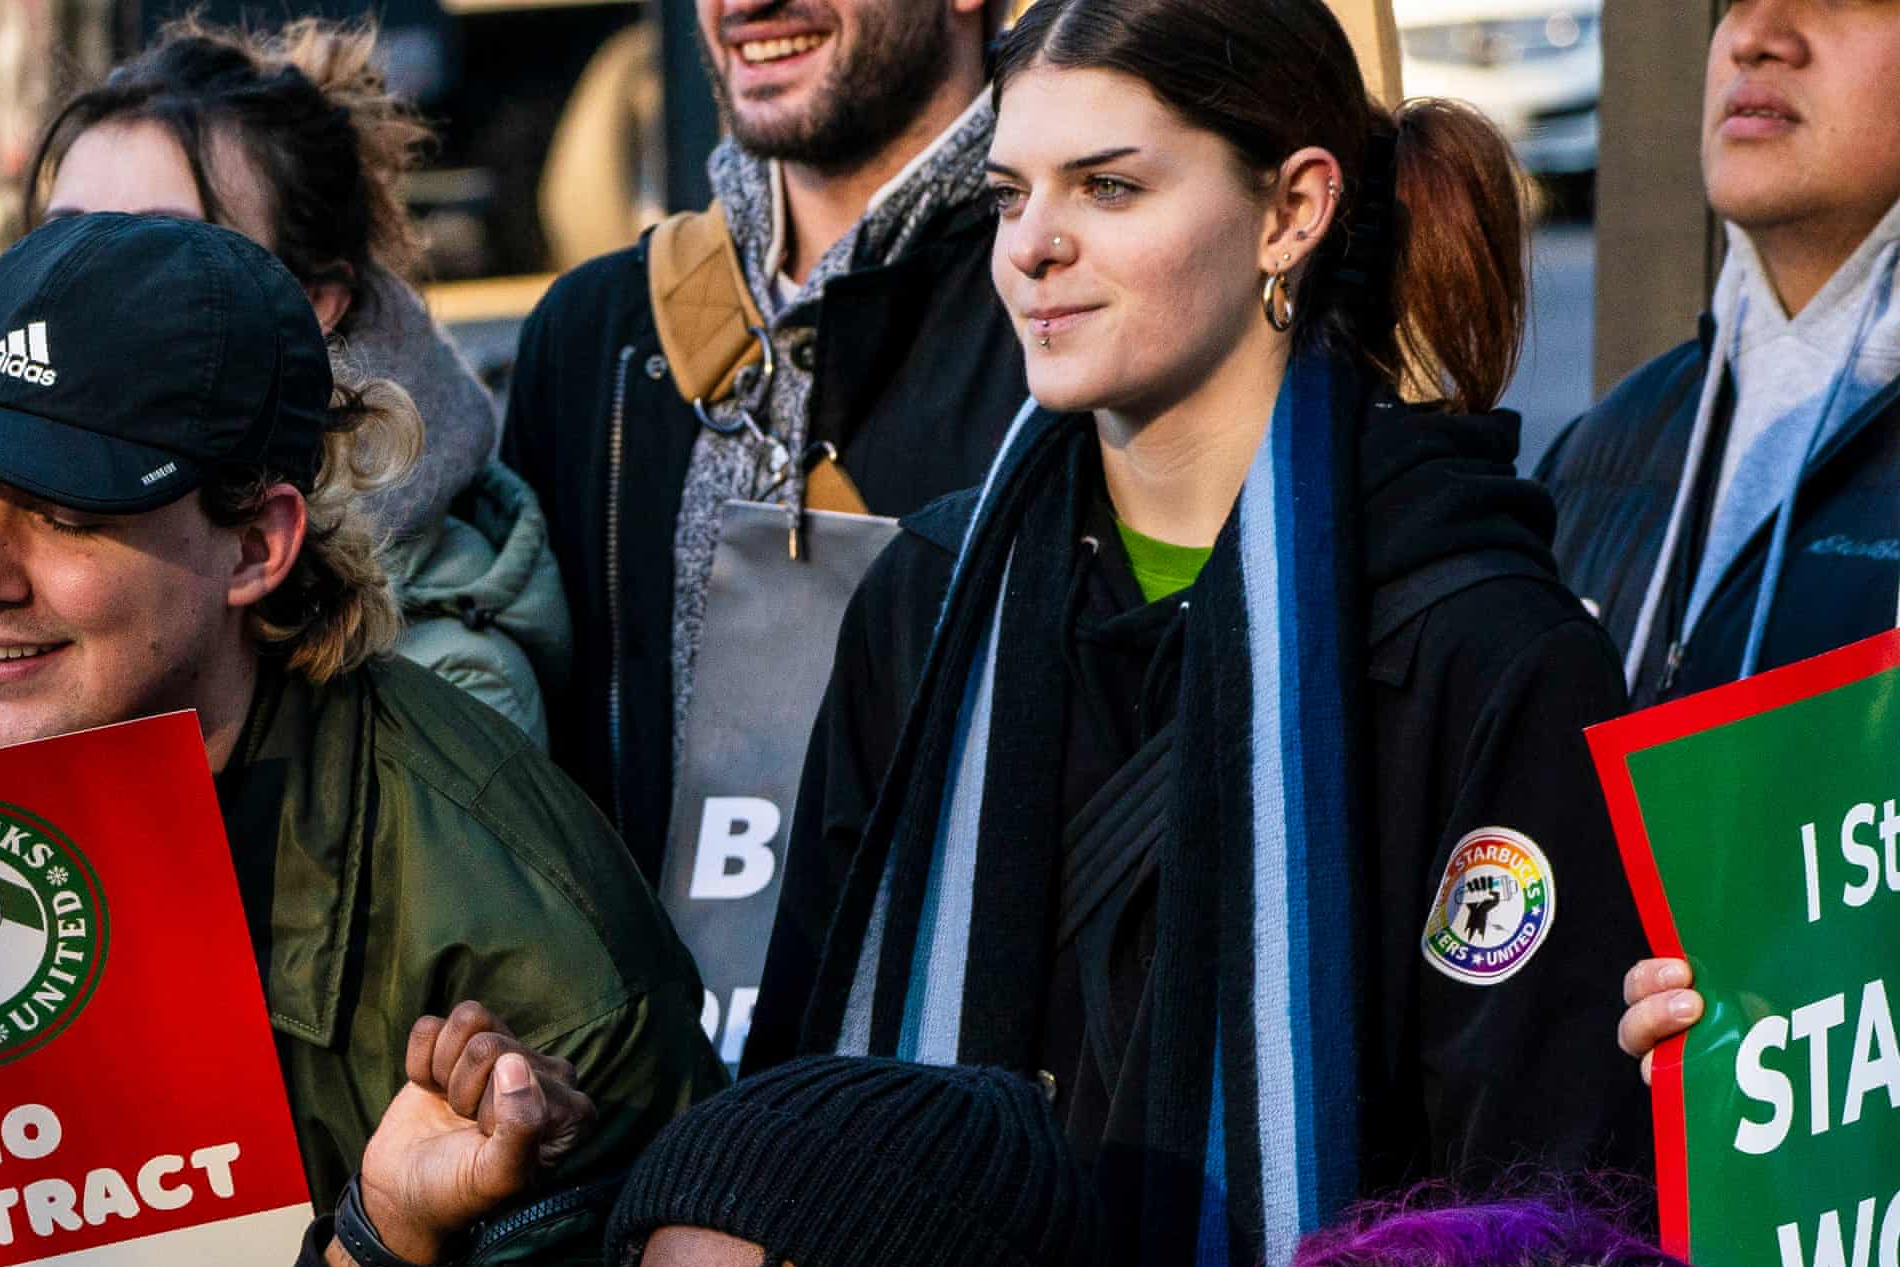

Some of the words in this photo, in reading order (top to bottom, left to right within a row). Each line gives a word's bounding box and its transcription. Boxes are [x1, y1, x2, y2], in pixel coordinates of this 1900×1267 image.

[1454, 845, 1541, 900] STARBUCKS
[1800, 821, 1822, 923] I
[7, 889, 86, 1031] UNITED
[1436, 932, 1469, 961] ERS
[1486, 922, 1537, 966] UNITED
